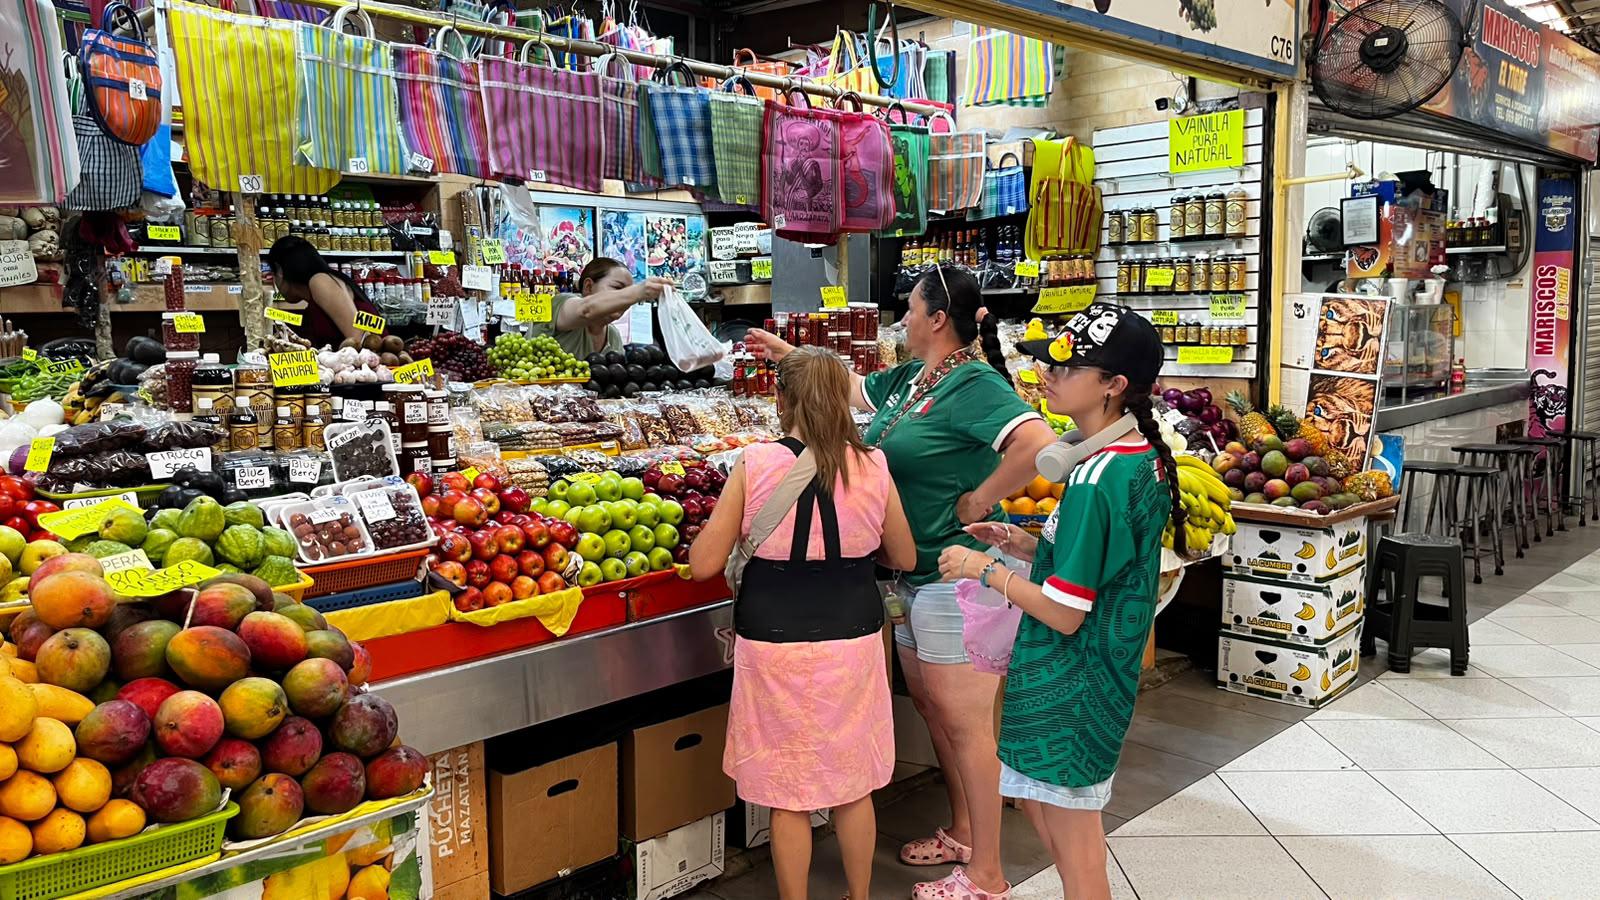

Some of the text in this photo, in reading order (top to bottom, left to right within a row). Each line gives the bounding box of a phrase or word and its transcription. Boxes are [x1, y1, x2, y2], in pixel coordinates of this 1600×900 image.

[1482, 4, 1541, 68] MARISCOS
[1271, 35, 1293, 59] C76
[1498, 60, 1529, 96] EL TIGRE
[1176, 113, 1229, 135] VAINILLA
[1193, 133, 1218, 147] PURA
[1176, 144, 1233, 165] NATURAL
[242, 176, 261, 191] 80
[1534, 264, 1558, 356] MARISCOS
[355, 312, 384, 331] KIWI
[270, 350, 317, 366] VAINILLA
[48, 361, 78, 373] EJOTE
[273, 363, 315, 380] NATURAL
[151, 449, 204, 461] CIRUELA
[238, 475, 268, 488] Berry
[291, 469, 318, 482] Berry
[103, 554, 143, 570] PERA
[1247, 558, 1258, 567] LA
[1258, 560, 1292, 571] CUMBRE
[1247, 616, 1292, 631] LA CUMBRE
[1242, 674, 1288, 691] LA CUMBRE
[436, 752, 454, 858] PUCHETA
